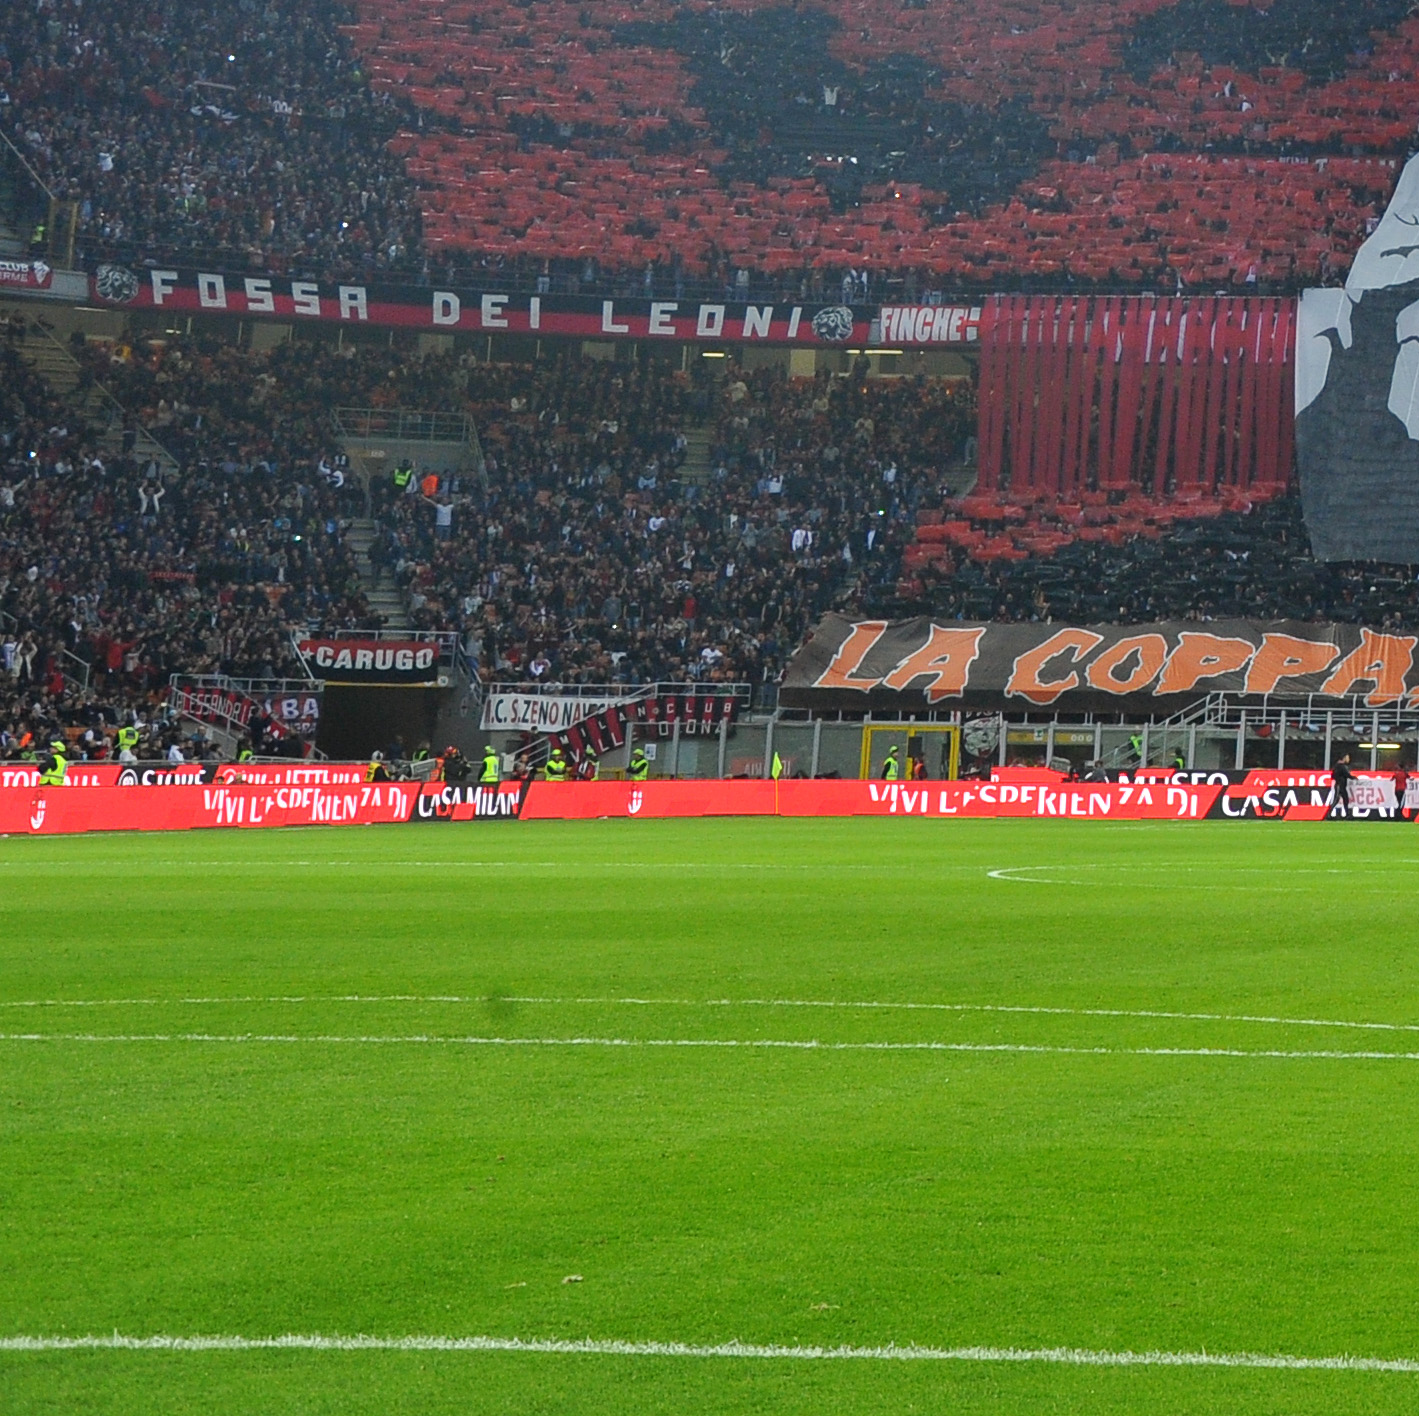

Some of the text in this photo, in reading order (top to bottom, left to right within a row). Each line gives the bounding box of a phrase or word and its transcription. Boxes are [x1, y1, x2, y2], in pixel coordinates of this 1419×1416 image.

[150, 270, 802, 339] FOSSA DEI LEONI
[316, 646, 435, 671] CARUGO
[812, 620, 987, 703] LA
[666, 702, 732, 714] CLUB
